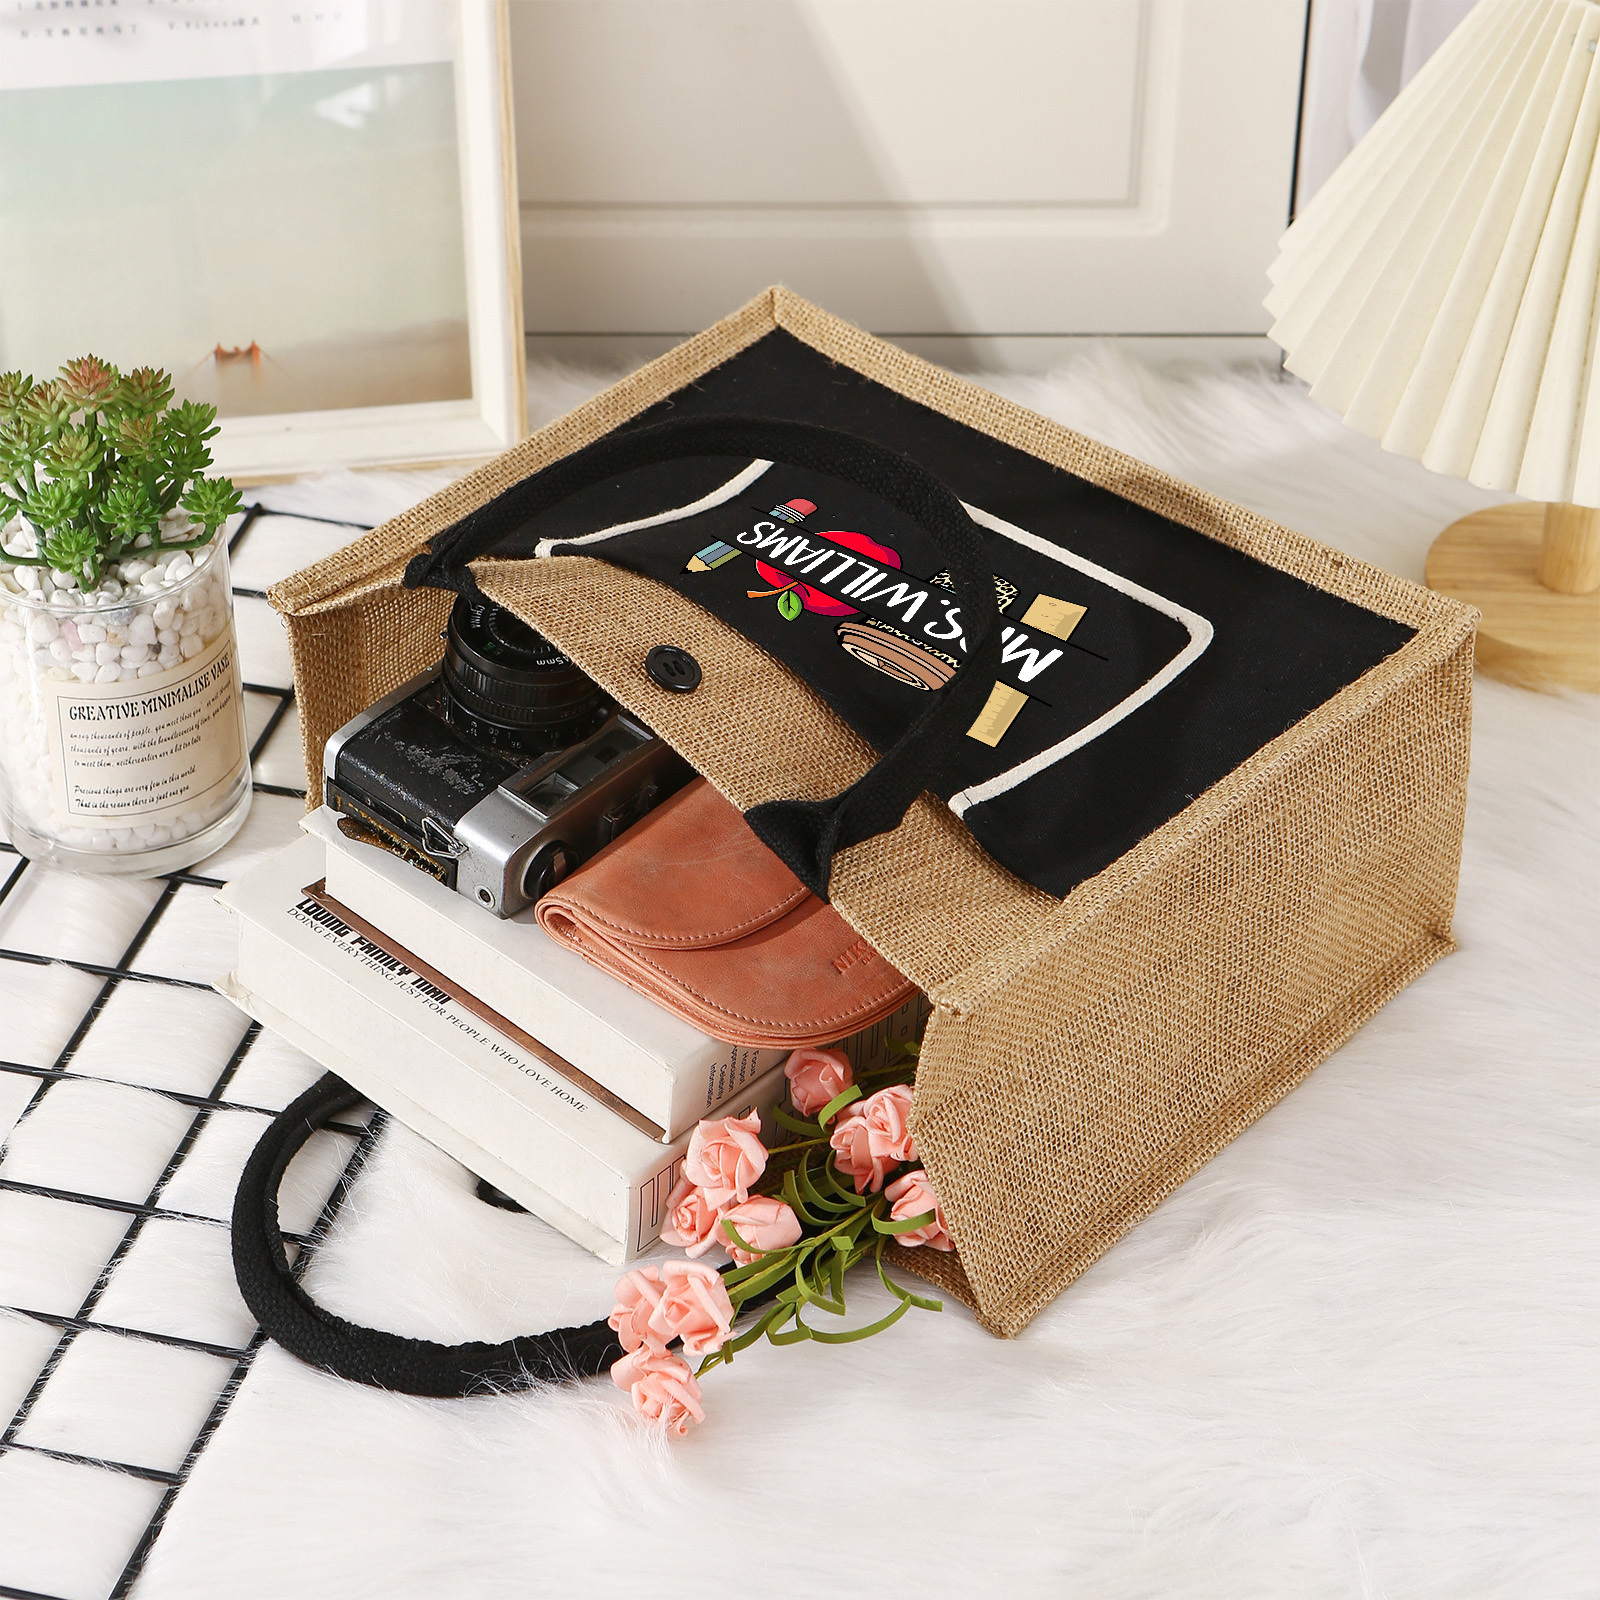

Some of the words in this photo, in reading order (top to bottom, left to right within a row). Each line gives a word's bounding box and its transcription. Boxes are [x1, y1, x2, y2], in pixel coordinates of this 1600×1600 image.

[736, 521, 928, 622] WILLIAMS
[470, 604, 485, 629] CHINA
[924, 599, 1064, 683] MS.
[69, 701, 140, 721] GREATIVE
[141, 671, 211, 715] MINIMALISE
[210, 652, 230, 681] VASE
[71, 744, 102, 754] thousands
[103, 745, 110, 756] of
[133, 740, 146, 750] with
[147, 738, 157, 748] the
[194, 719, 200, 730] of
[90, 731, 122, 740] thousands
[123, 730, 130, 740] of
[155, 724, 165, 734] you
[166, 717, 179, 727] meet
[174, 743, 182, 753] bit
[74, 784, 102, 795] Precious
[103, 786, 123, 797] things
[149, 780, 160, 791] few
[168, 773, 180, 783] this
[75, 798, 91, 808] That
[99, 800, 109, 809] the
[132, 797, 148, 807] there
[155, 791, 169, 804] just
[169, 789, 179, 797] one
[350, 935, 413, 977] FAMILY
[410, 976, 453, 1006] MAN
[286, 907, 324, 934] DOING
[323, 932, 395, 981] EVERYTHING
[394, 979, 425, 1000] JUST
[422, 998, 447, 1017] FOR
[446, 1013, 491, 1046] PEOPLE
[490, 1043, 519, 1065] WHO
[517, 1063, 552, 1088] LOVE
[550, 1085, 589, 1113] HOME
[716, 1063, 728, 1100] Celebrity
[738, 1051, 748, 1085] Hotspot
[750, 1049, 759, 1077] Focus
[706, 1062, 717, 1109] Information
